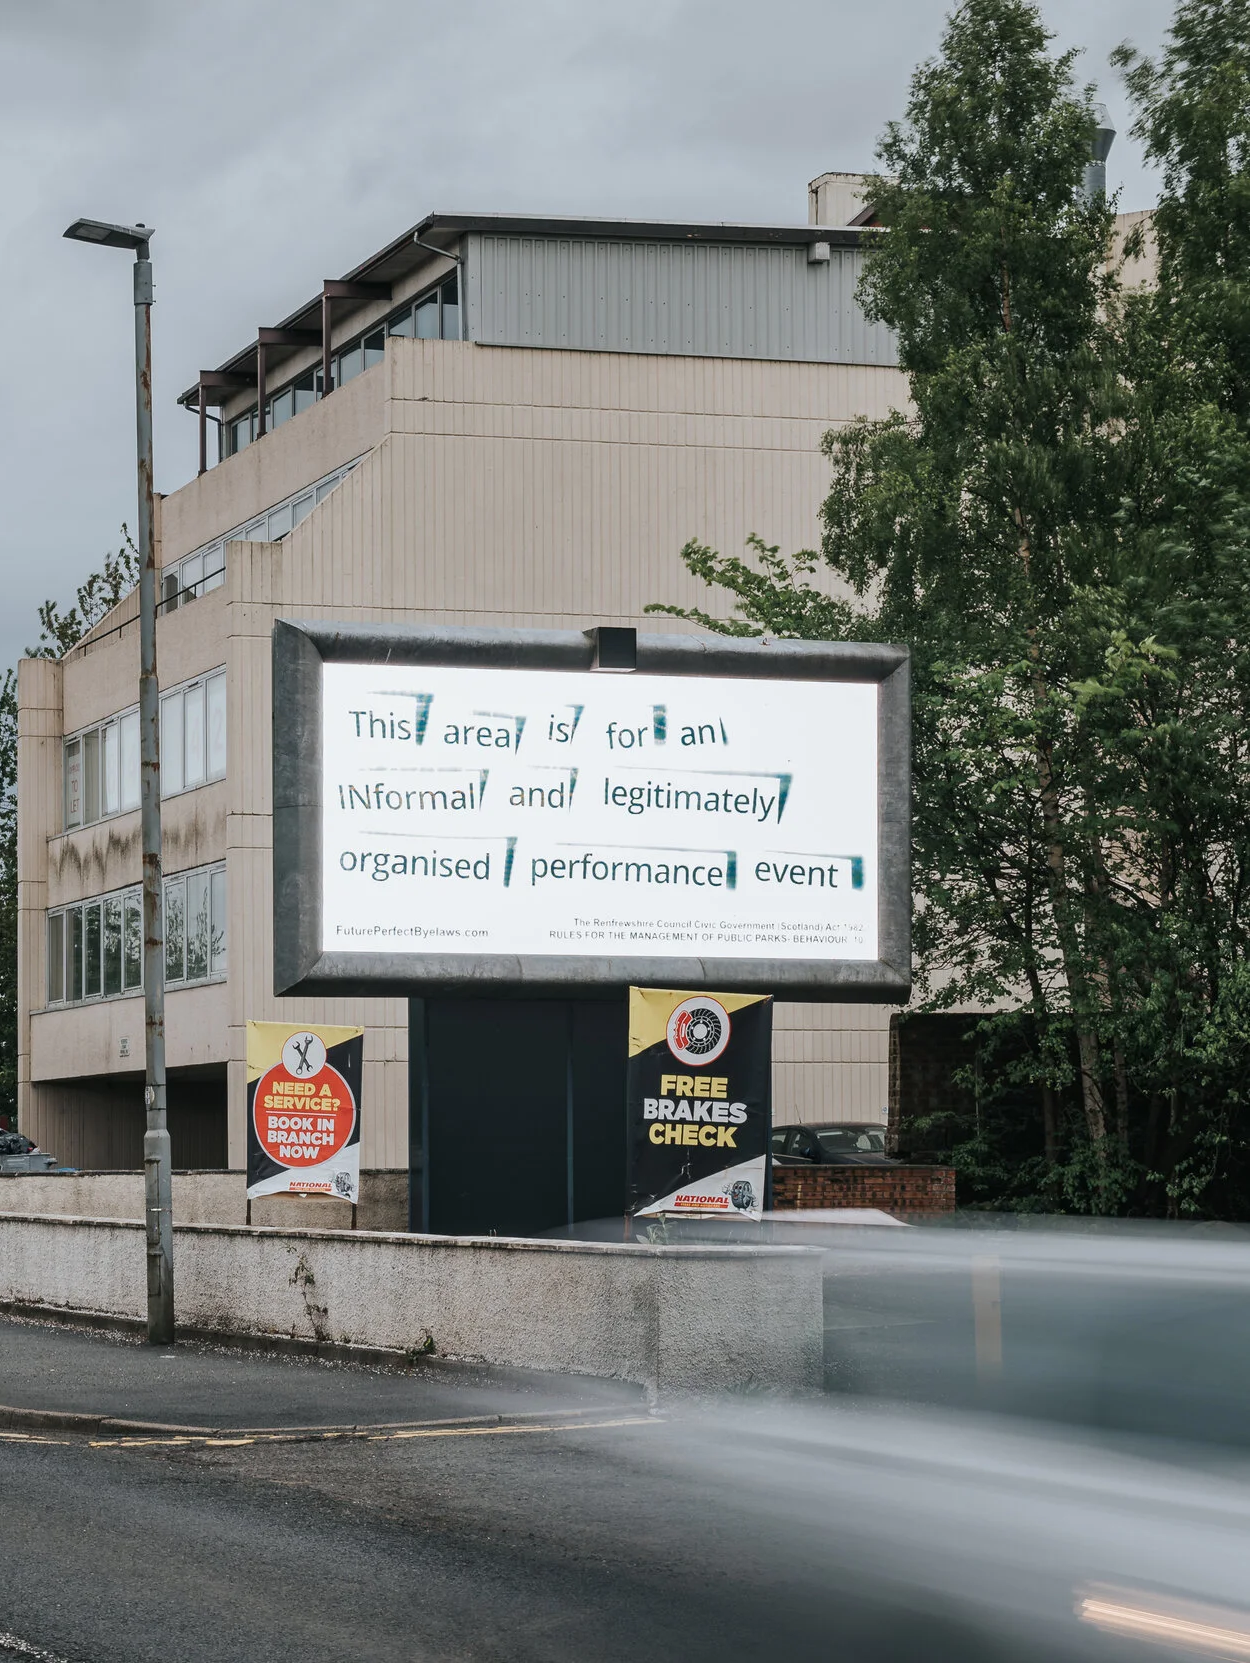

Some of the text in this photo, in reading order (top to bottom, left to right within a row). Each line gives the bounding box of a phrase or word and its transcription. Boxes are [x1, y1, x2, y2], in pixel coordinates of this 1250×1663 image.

[348, 710, 715, 749] This area is for an
[338, 777, 776, 823] INformal and legitimately
[340, 850, 839, 888] organised performance event
[336, 925, 489, 938] FuturePerfectByelaws.com
[574, 918, 590, 927] The
[594, 918, 654, 928] Renfrewshire
[656, 919, 692, 928] Council
[694, 920, 716, 929] Civic
[719, 920, 774, 930] Government
[826, 923, 840, 931] Act
[550, 930, 582, 940] RULES
[585, 931, 604, 940] FOR
[608, 931, 626, 940] THE
[630, 932, 698, 941] MANAGEMENT
[702, 933, 714, 941] OF
[718, 933, 752, 942] PUBLIC
[793, 934, 848, 944] BEHAVIOUR
[272, 1081, 332, 1096] NEED A
[660, 1074, 728, 1099] FREE
[264, 1095, 341, 1112] SERVICE?
[643, 1098, 748, 1124] BRAKES
[268, 1116, 334, 1132] BOOK IN
[268, 1131, 334, 1146] BRANCH
[649, 1123, 738, 1148] CHECK
[279, 1145, 320, 1160] NOW
[675, 1195, 729, 1203] NATIONAL
